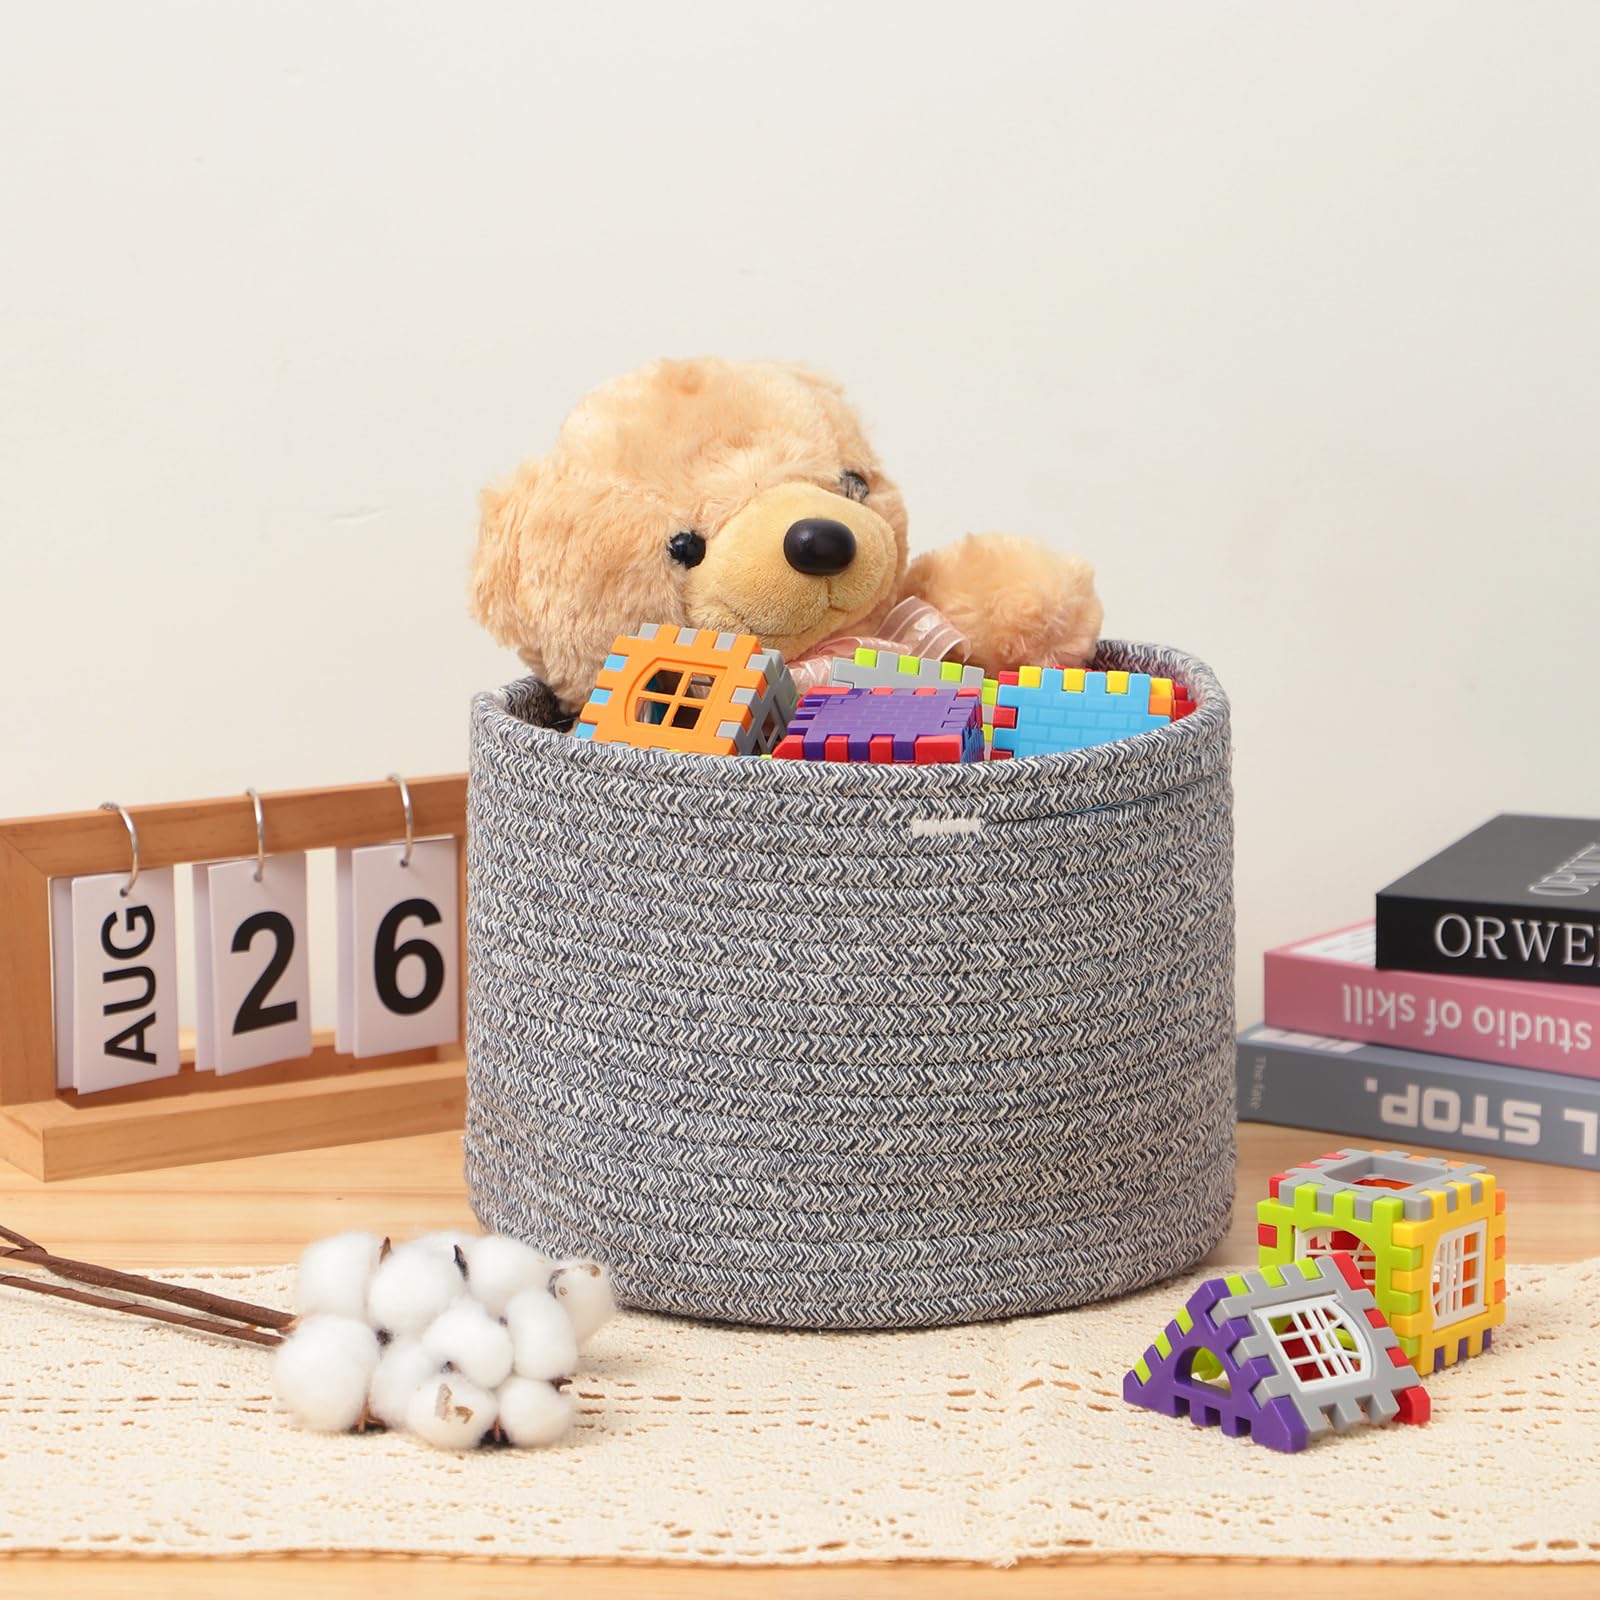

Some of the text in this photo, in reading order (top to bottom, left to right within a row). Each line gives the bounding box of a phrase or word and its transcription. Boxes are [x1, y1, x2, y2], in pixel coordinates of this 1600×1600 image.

[101, 904, 157, 1065] AUG
[230, 911, 298, 1036] 2
[373, 898, 445, 1017] 6
[1434, 913, 1600, 968] ORWE
[1342, 984, 1593, 1054] studio of skill
[1365, 1077, 1542, 1146] STOP.
